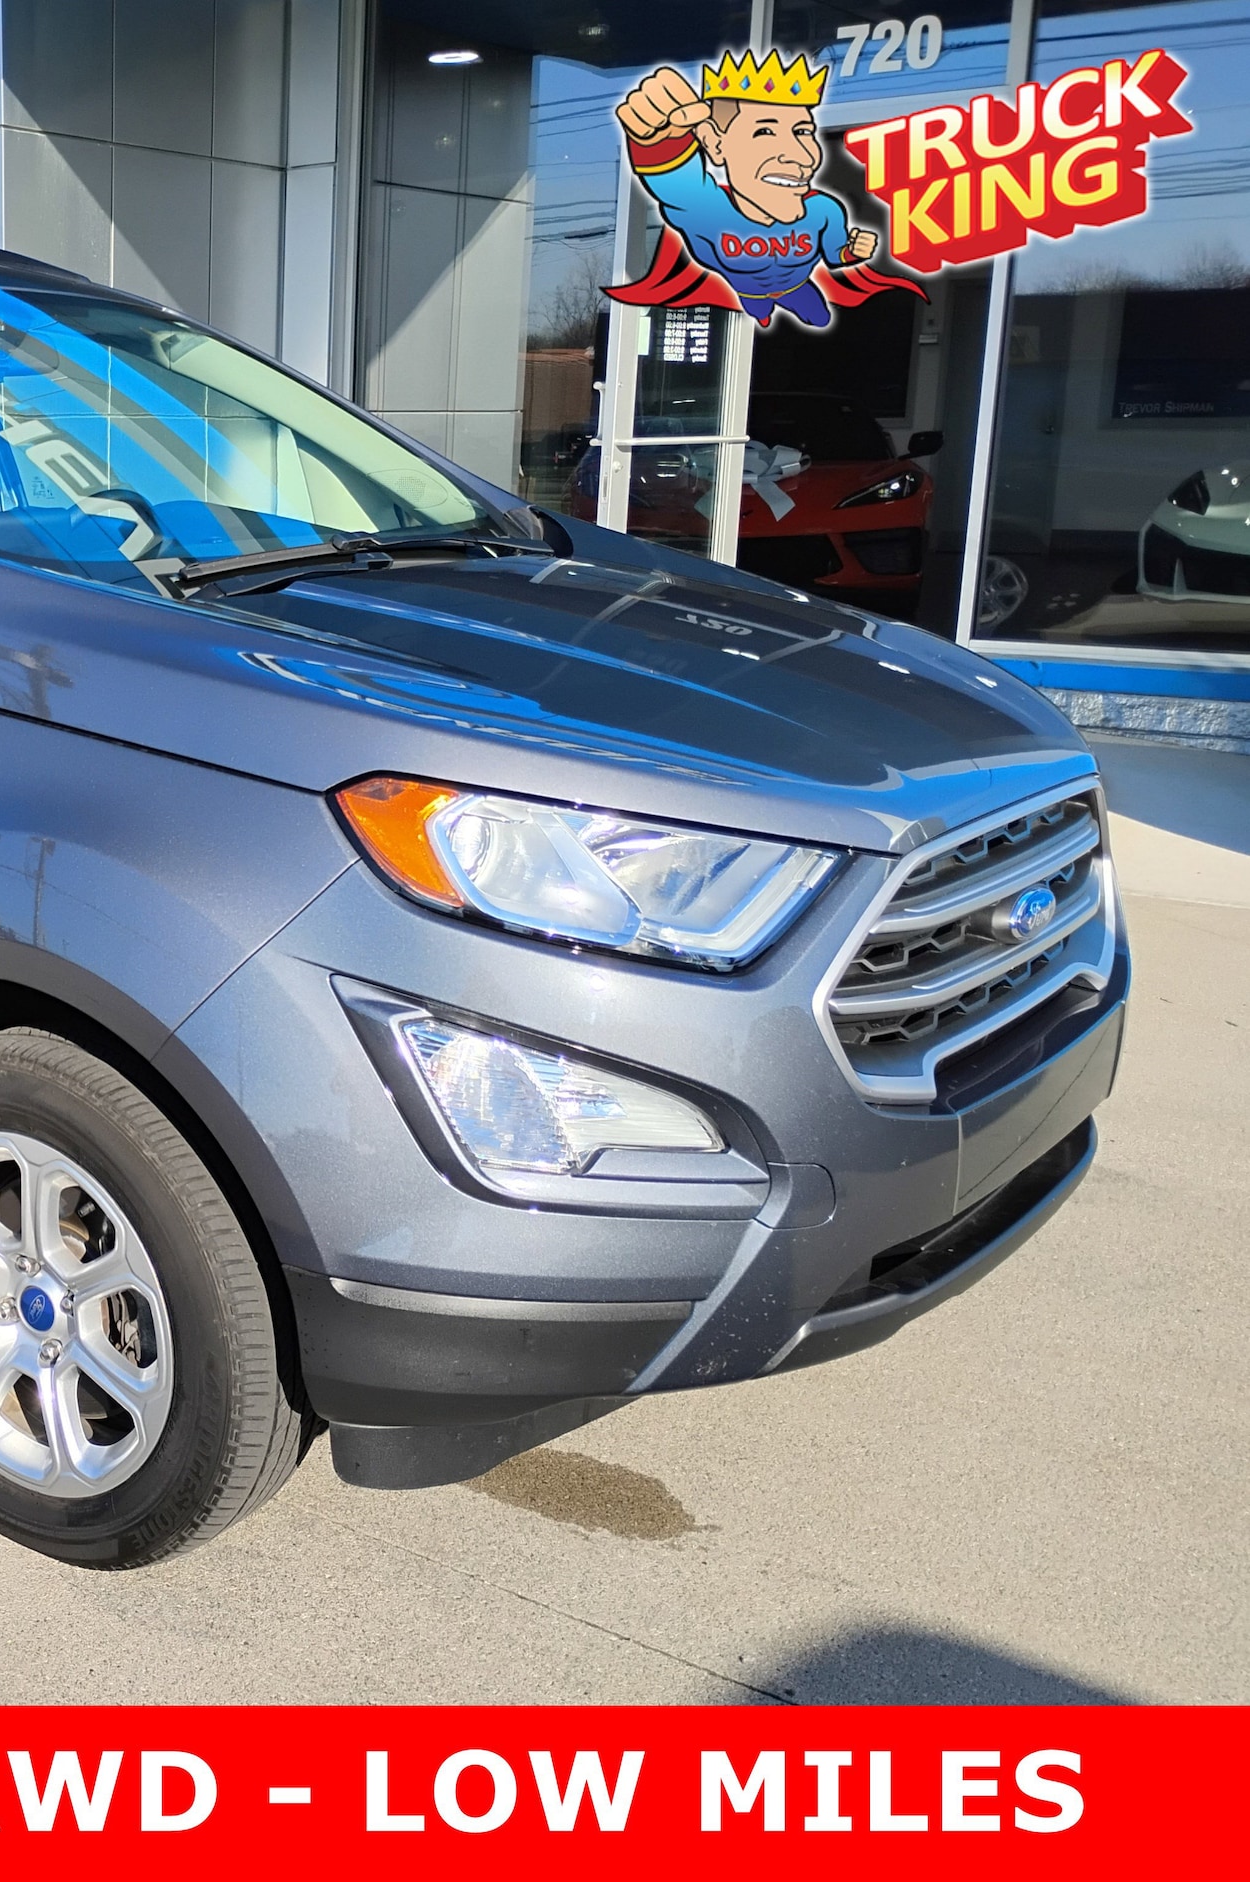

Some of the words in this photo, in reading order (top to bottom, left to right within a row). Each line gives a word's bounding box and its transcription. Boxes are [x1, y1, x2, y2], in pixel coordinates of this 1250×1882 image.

[836, 14, 943, 77] 720
[1118, 401, 1161, 414] TREVOR
[1164, 401, 1215, 414] SHIPMAN
